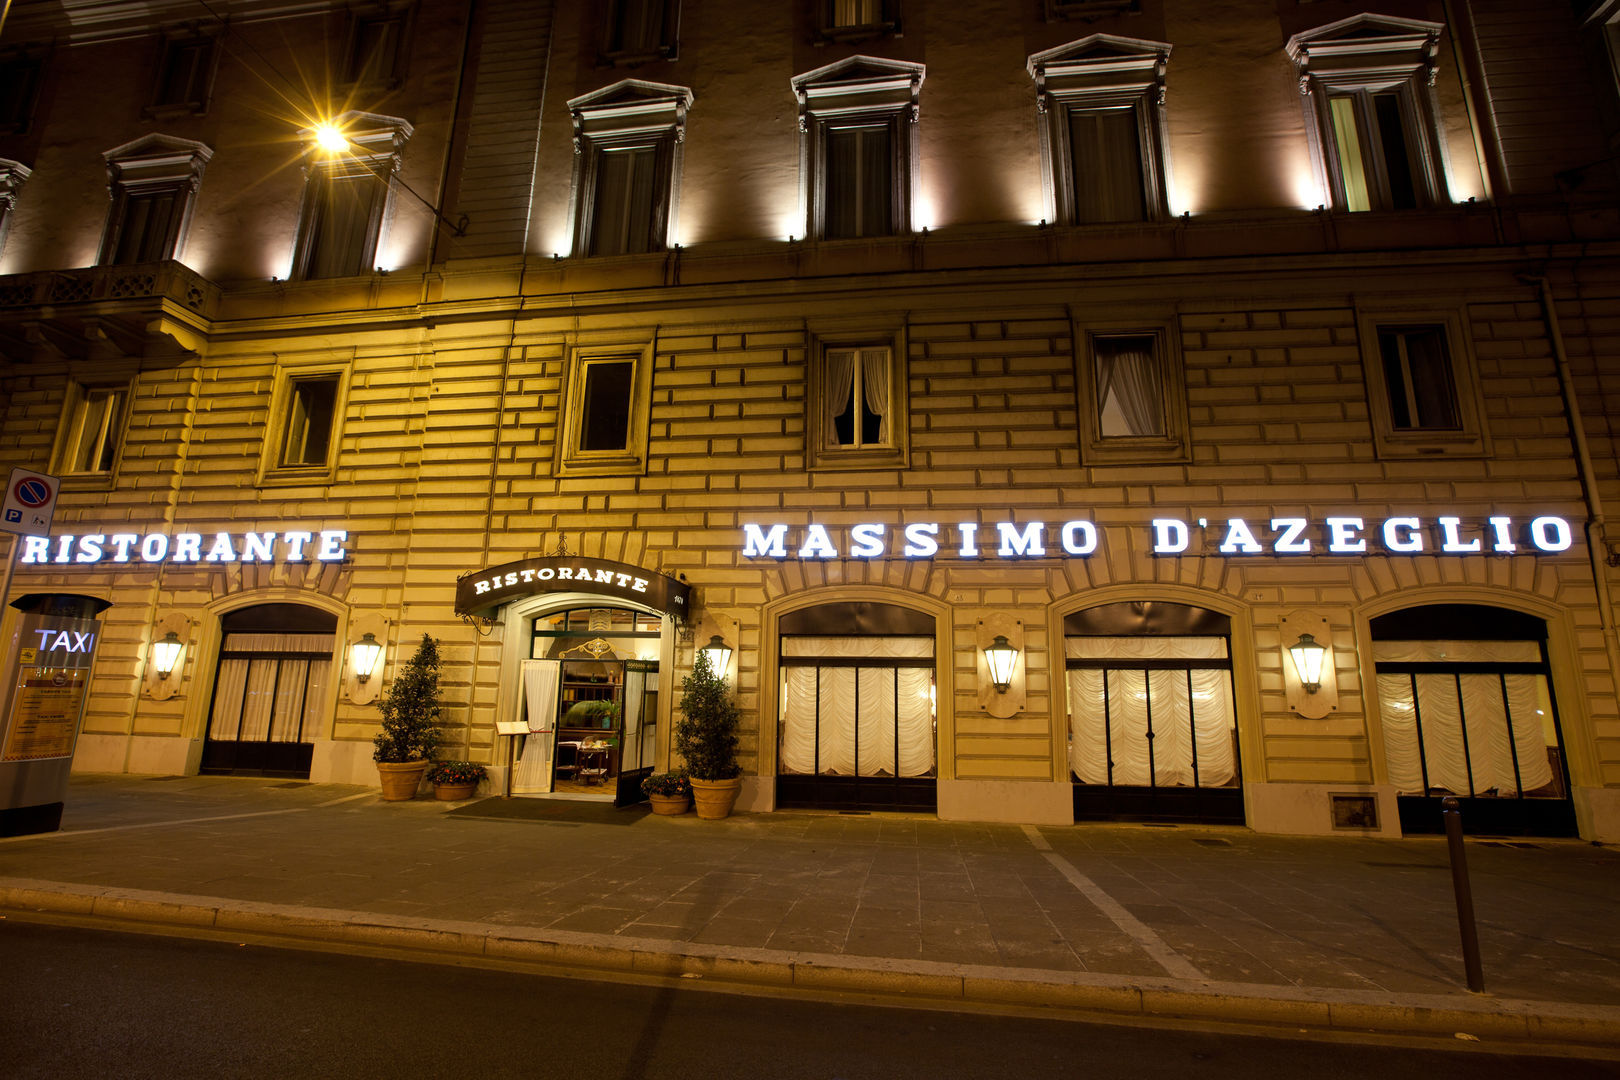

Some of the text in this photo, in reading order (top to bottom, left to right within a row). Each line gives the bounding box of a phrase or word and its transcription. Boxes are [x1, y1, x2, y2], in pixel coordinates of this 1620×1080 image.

[22, 530, 346, 562] RISTORANTE
[743, 517, 1571, 557] MASSIMO D'AZEGLIO
[475, 568, 648, 600] RISTORANTE
[36, 630, 93, 652] TAXI
